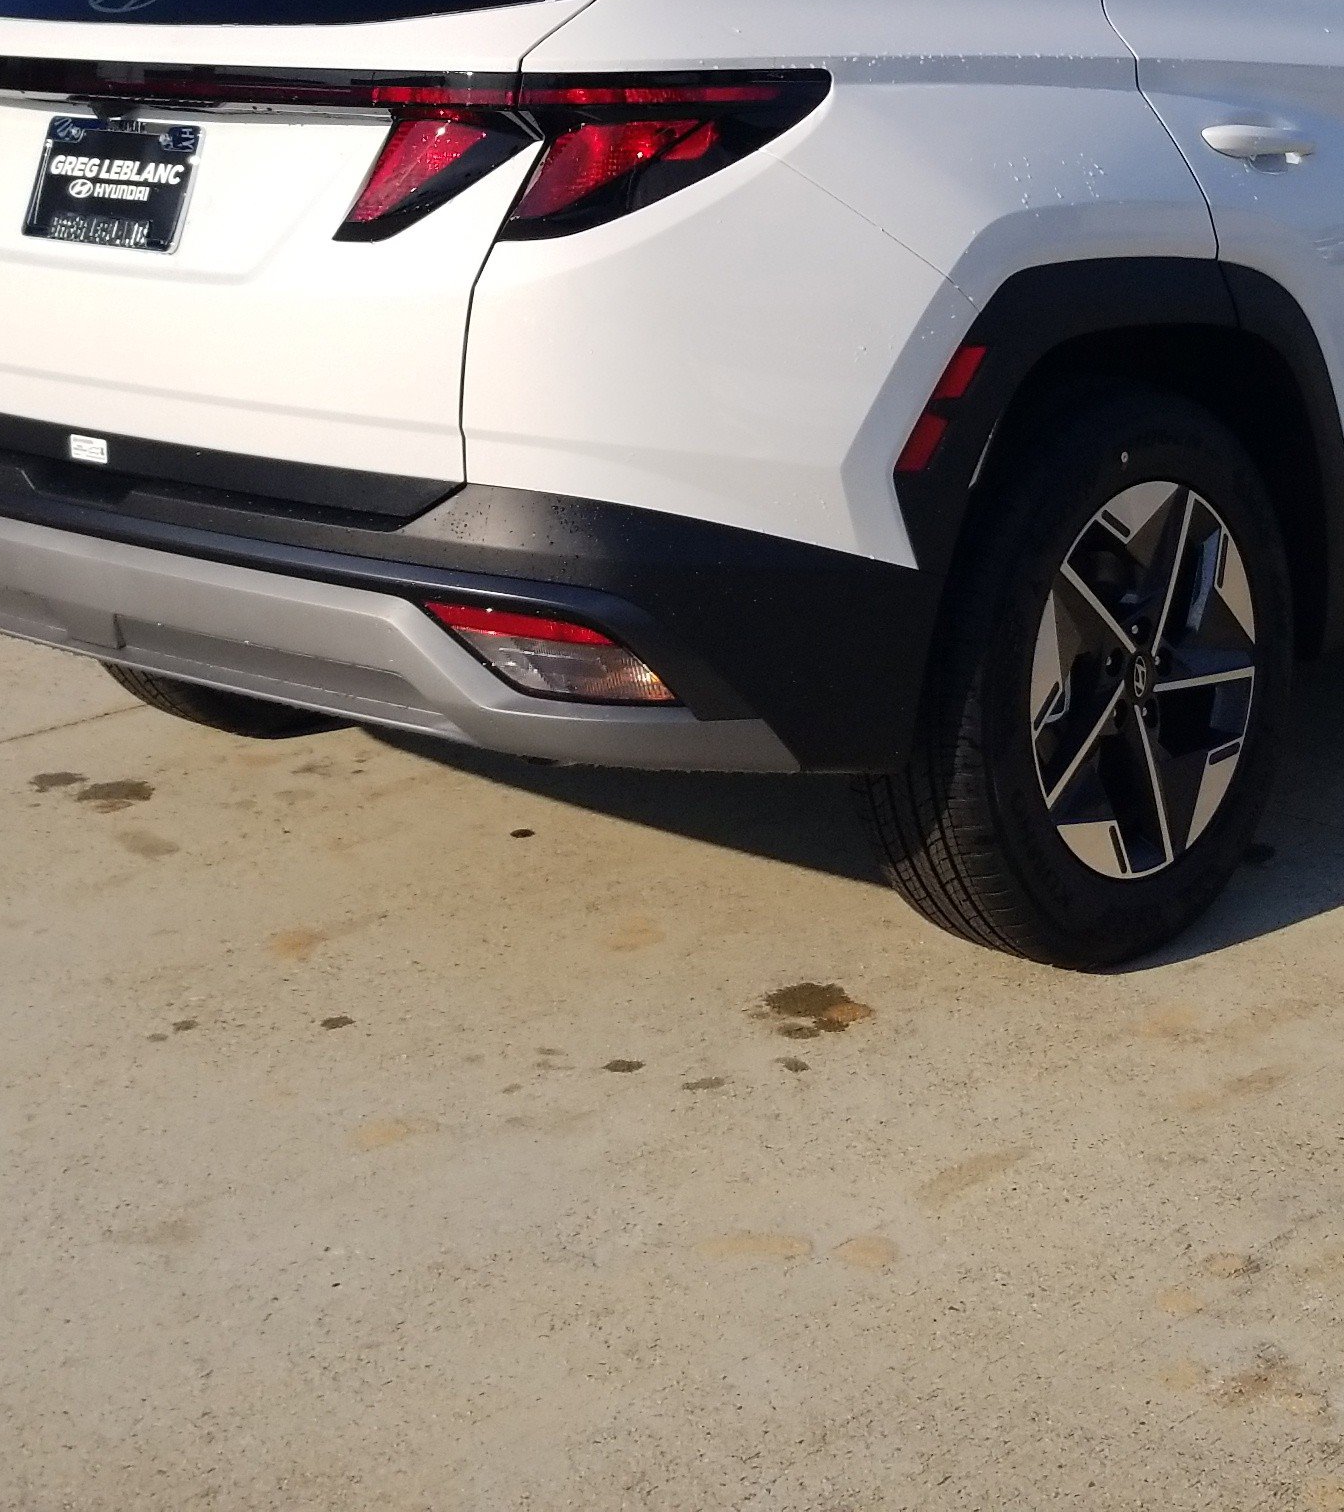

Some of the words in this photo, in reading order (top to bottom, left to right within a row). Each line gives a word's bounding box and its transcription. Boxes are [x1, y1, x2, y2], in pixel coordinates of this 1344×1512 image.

[50, 154, 101, 178] GREG
[98, 159, 185, 185] LEBLANC
[93, 183, 151, 202] HYUNDAI
